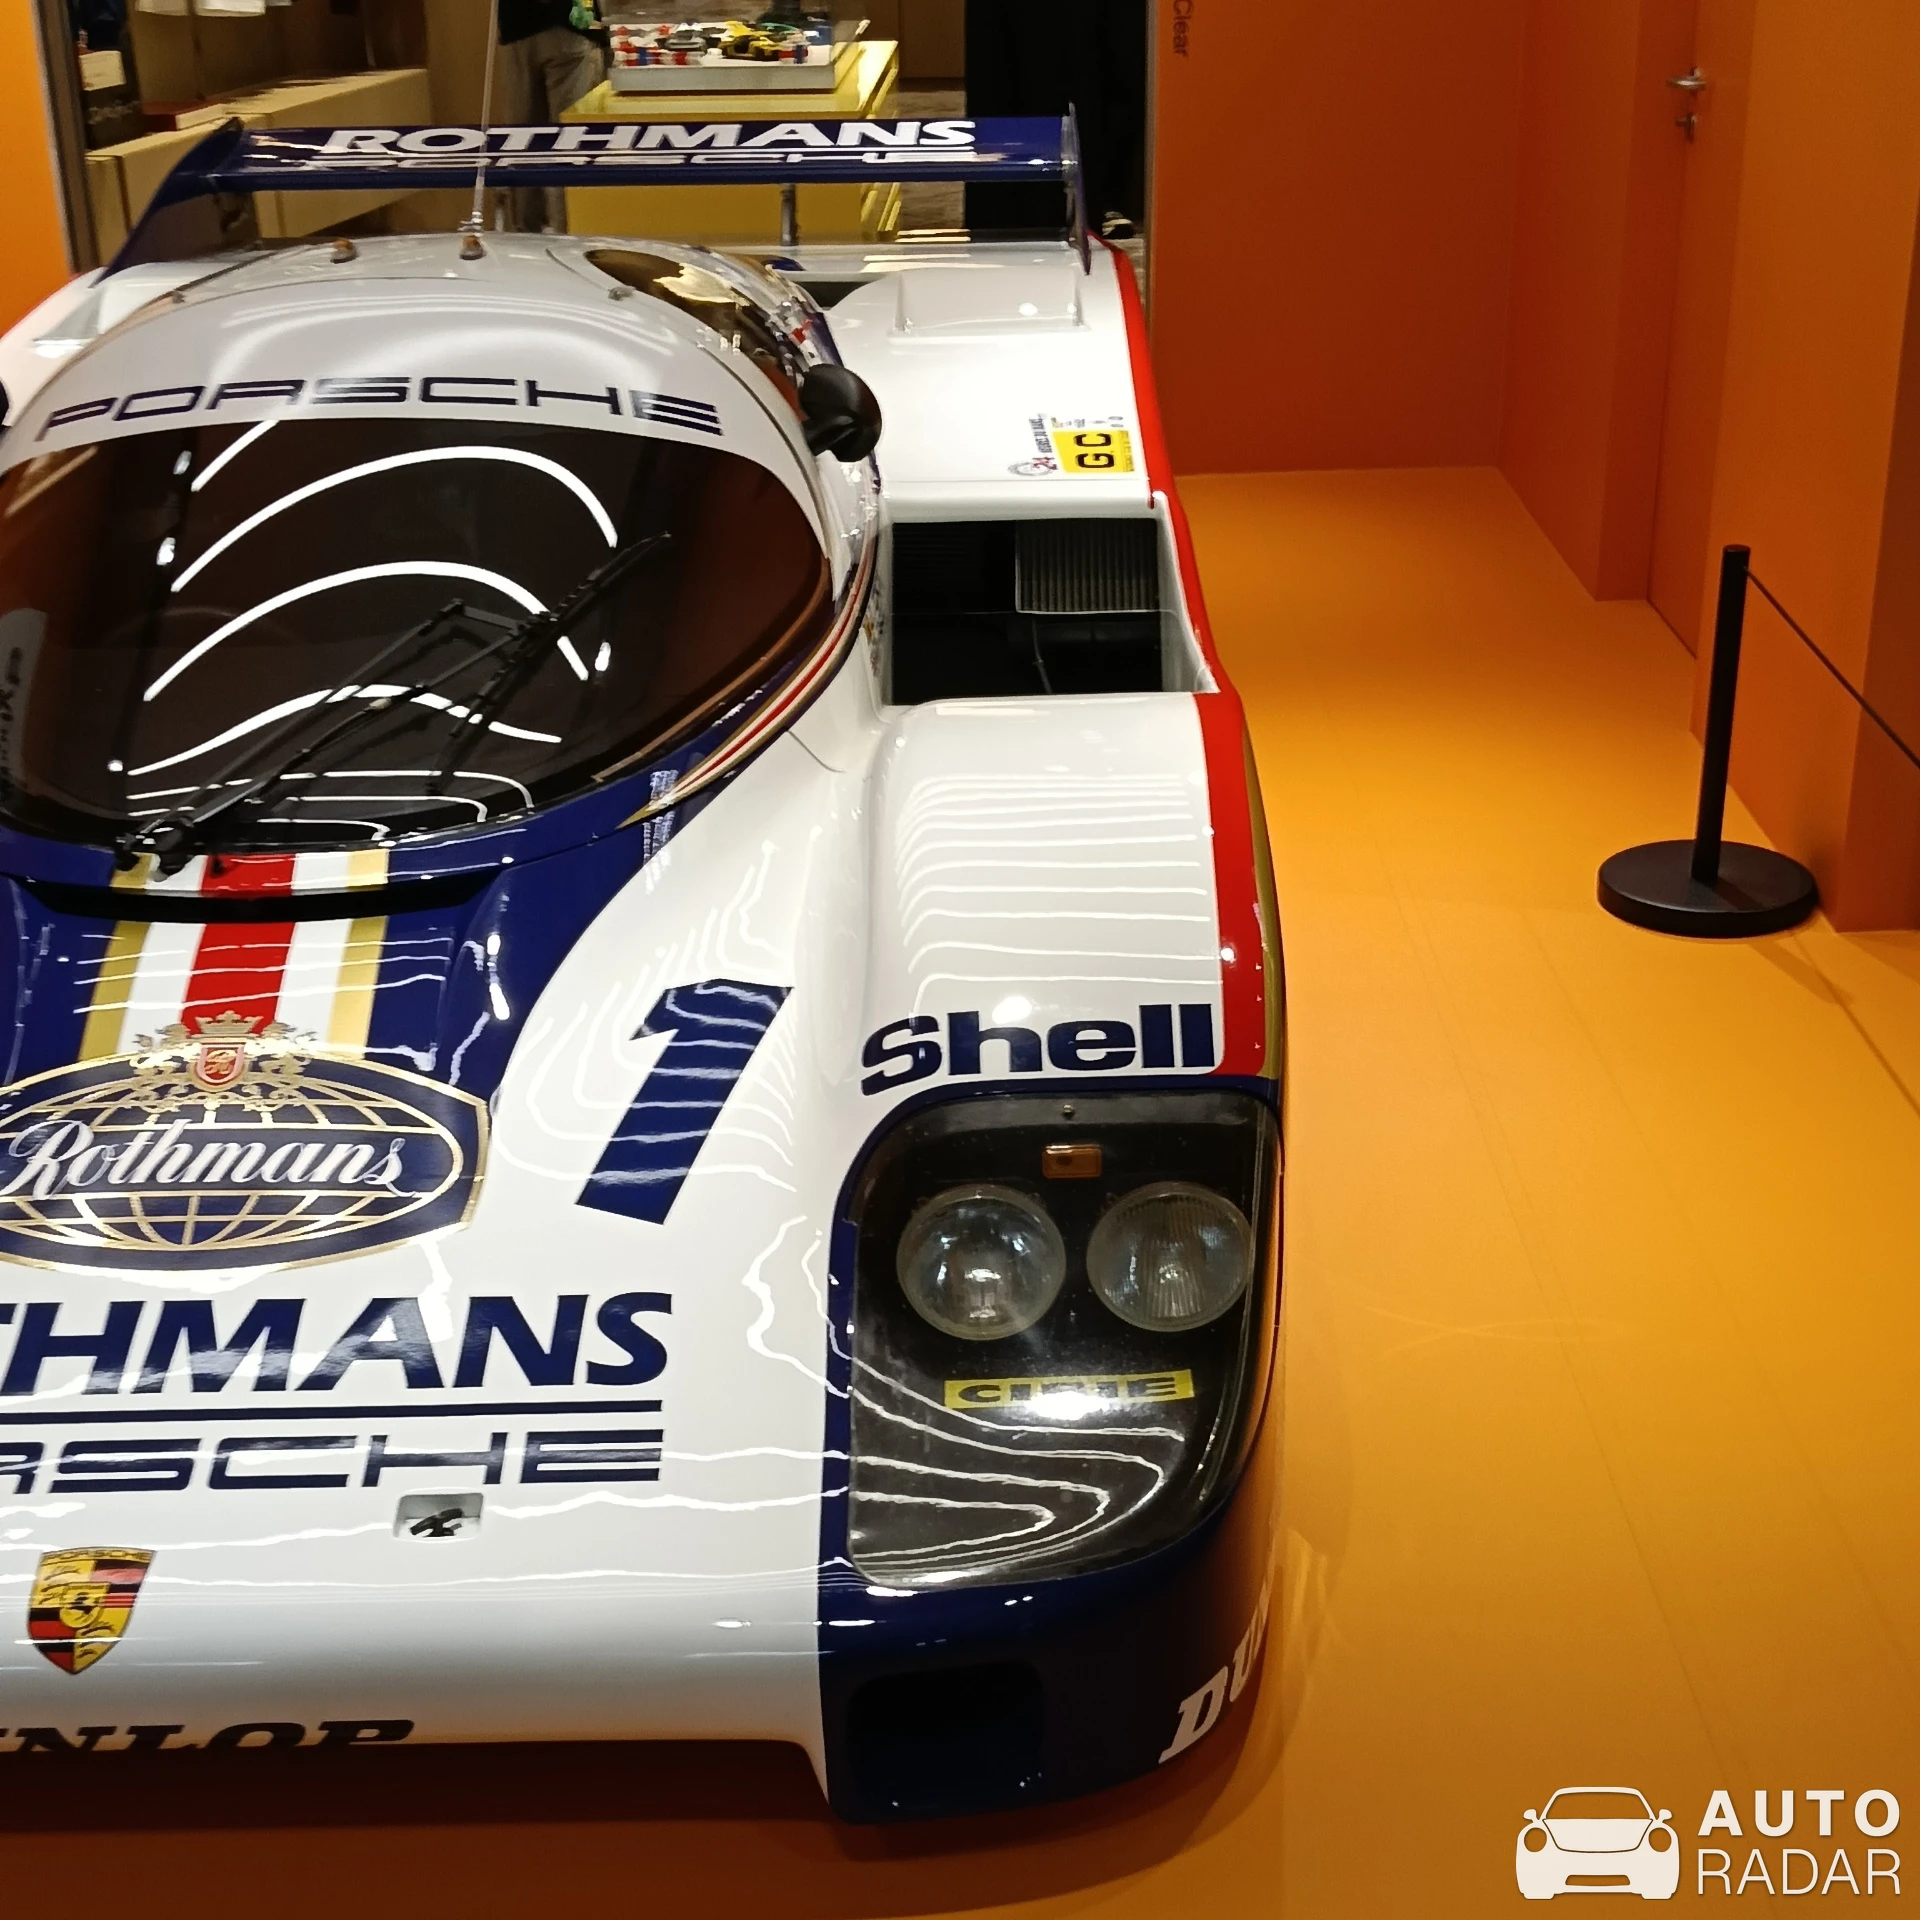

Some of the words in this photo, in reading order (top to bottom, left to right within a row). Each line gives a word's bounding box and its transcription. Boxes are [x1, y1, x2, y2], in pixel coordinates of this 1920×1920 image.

[1173, 0, 1193, 57] Clear
[320, 120, 976, 154] ROTHMANS
[35, 376, 725, 441] PORSCHE
[861, 1003, 1215, 1096] Shell
[575, 978, 793, 1225] 1
[1, 1118, 418, 1200] Rothmans
[0, 1292, 672, 1395] HMANS
[1158, 1562, 1274, 1764] DU
[0, 1719, 415, 1752] NLOP
